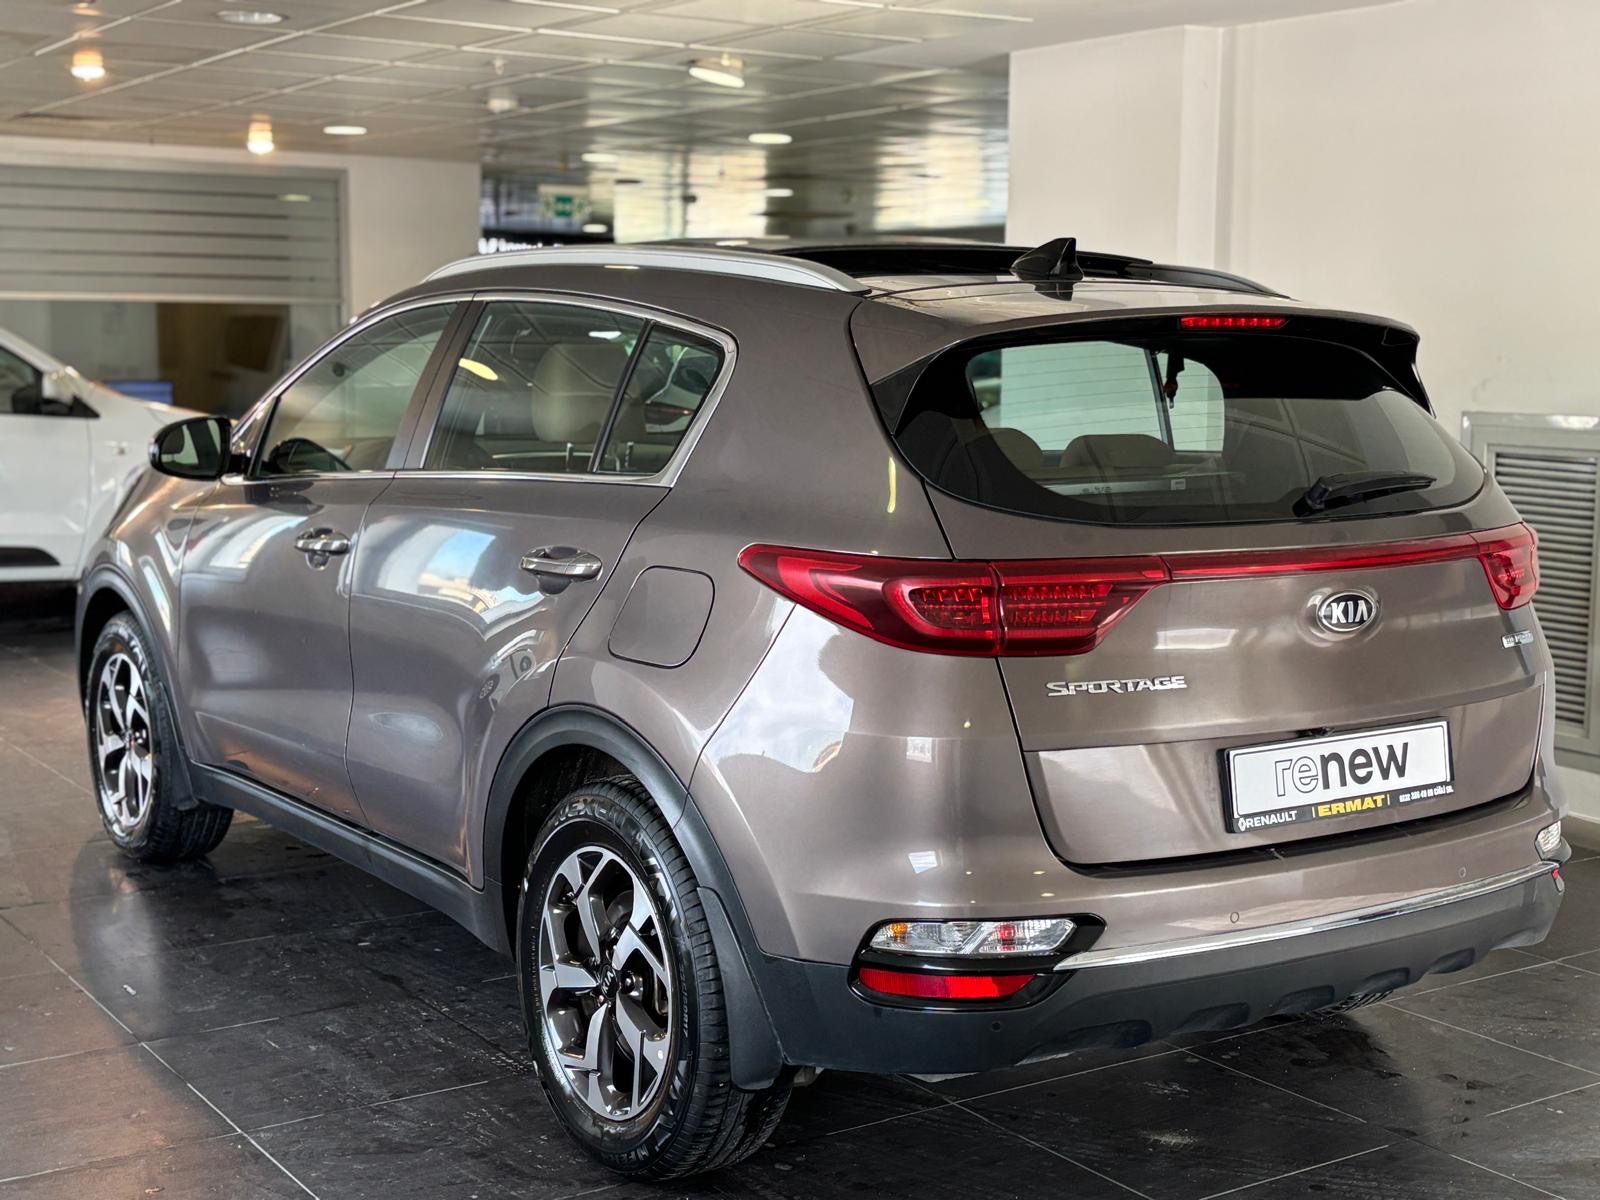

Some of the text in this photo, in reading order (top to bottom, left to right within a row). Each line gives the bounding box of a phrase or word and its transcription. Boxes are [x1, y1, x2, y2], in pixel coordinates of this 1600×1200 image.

[1330, 600, 1368, 624] KIA
[1046, 675, 1187, 697] SPORTAGE
[1275, 741, 1409, 797] renew
[1245, 794, 1385, 829] RENAULT ERMAT
